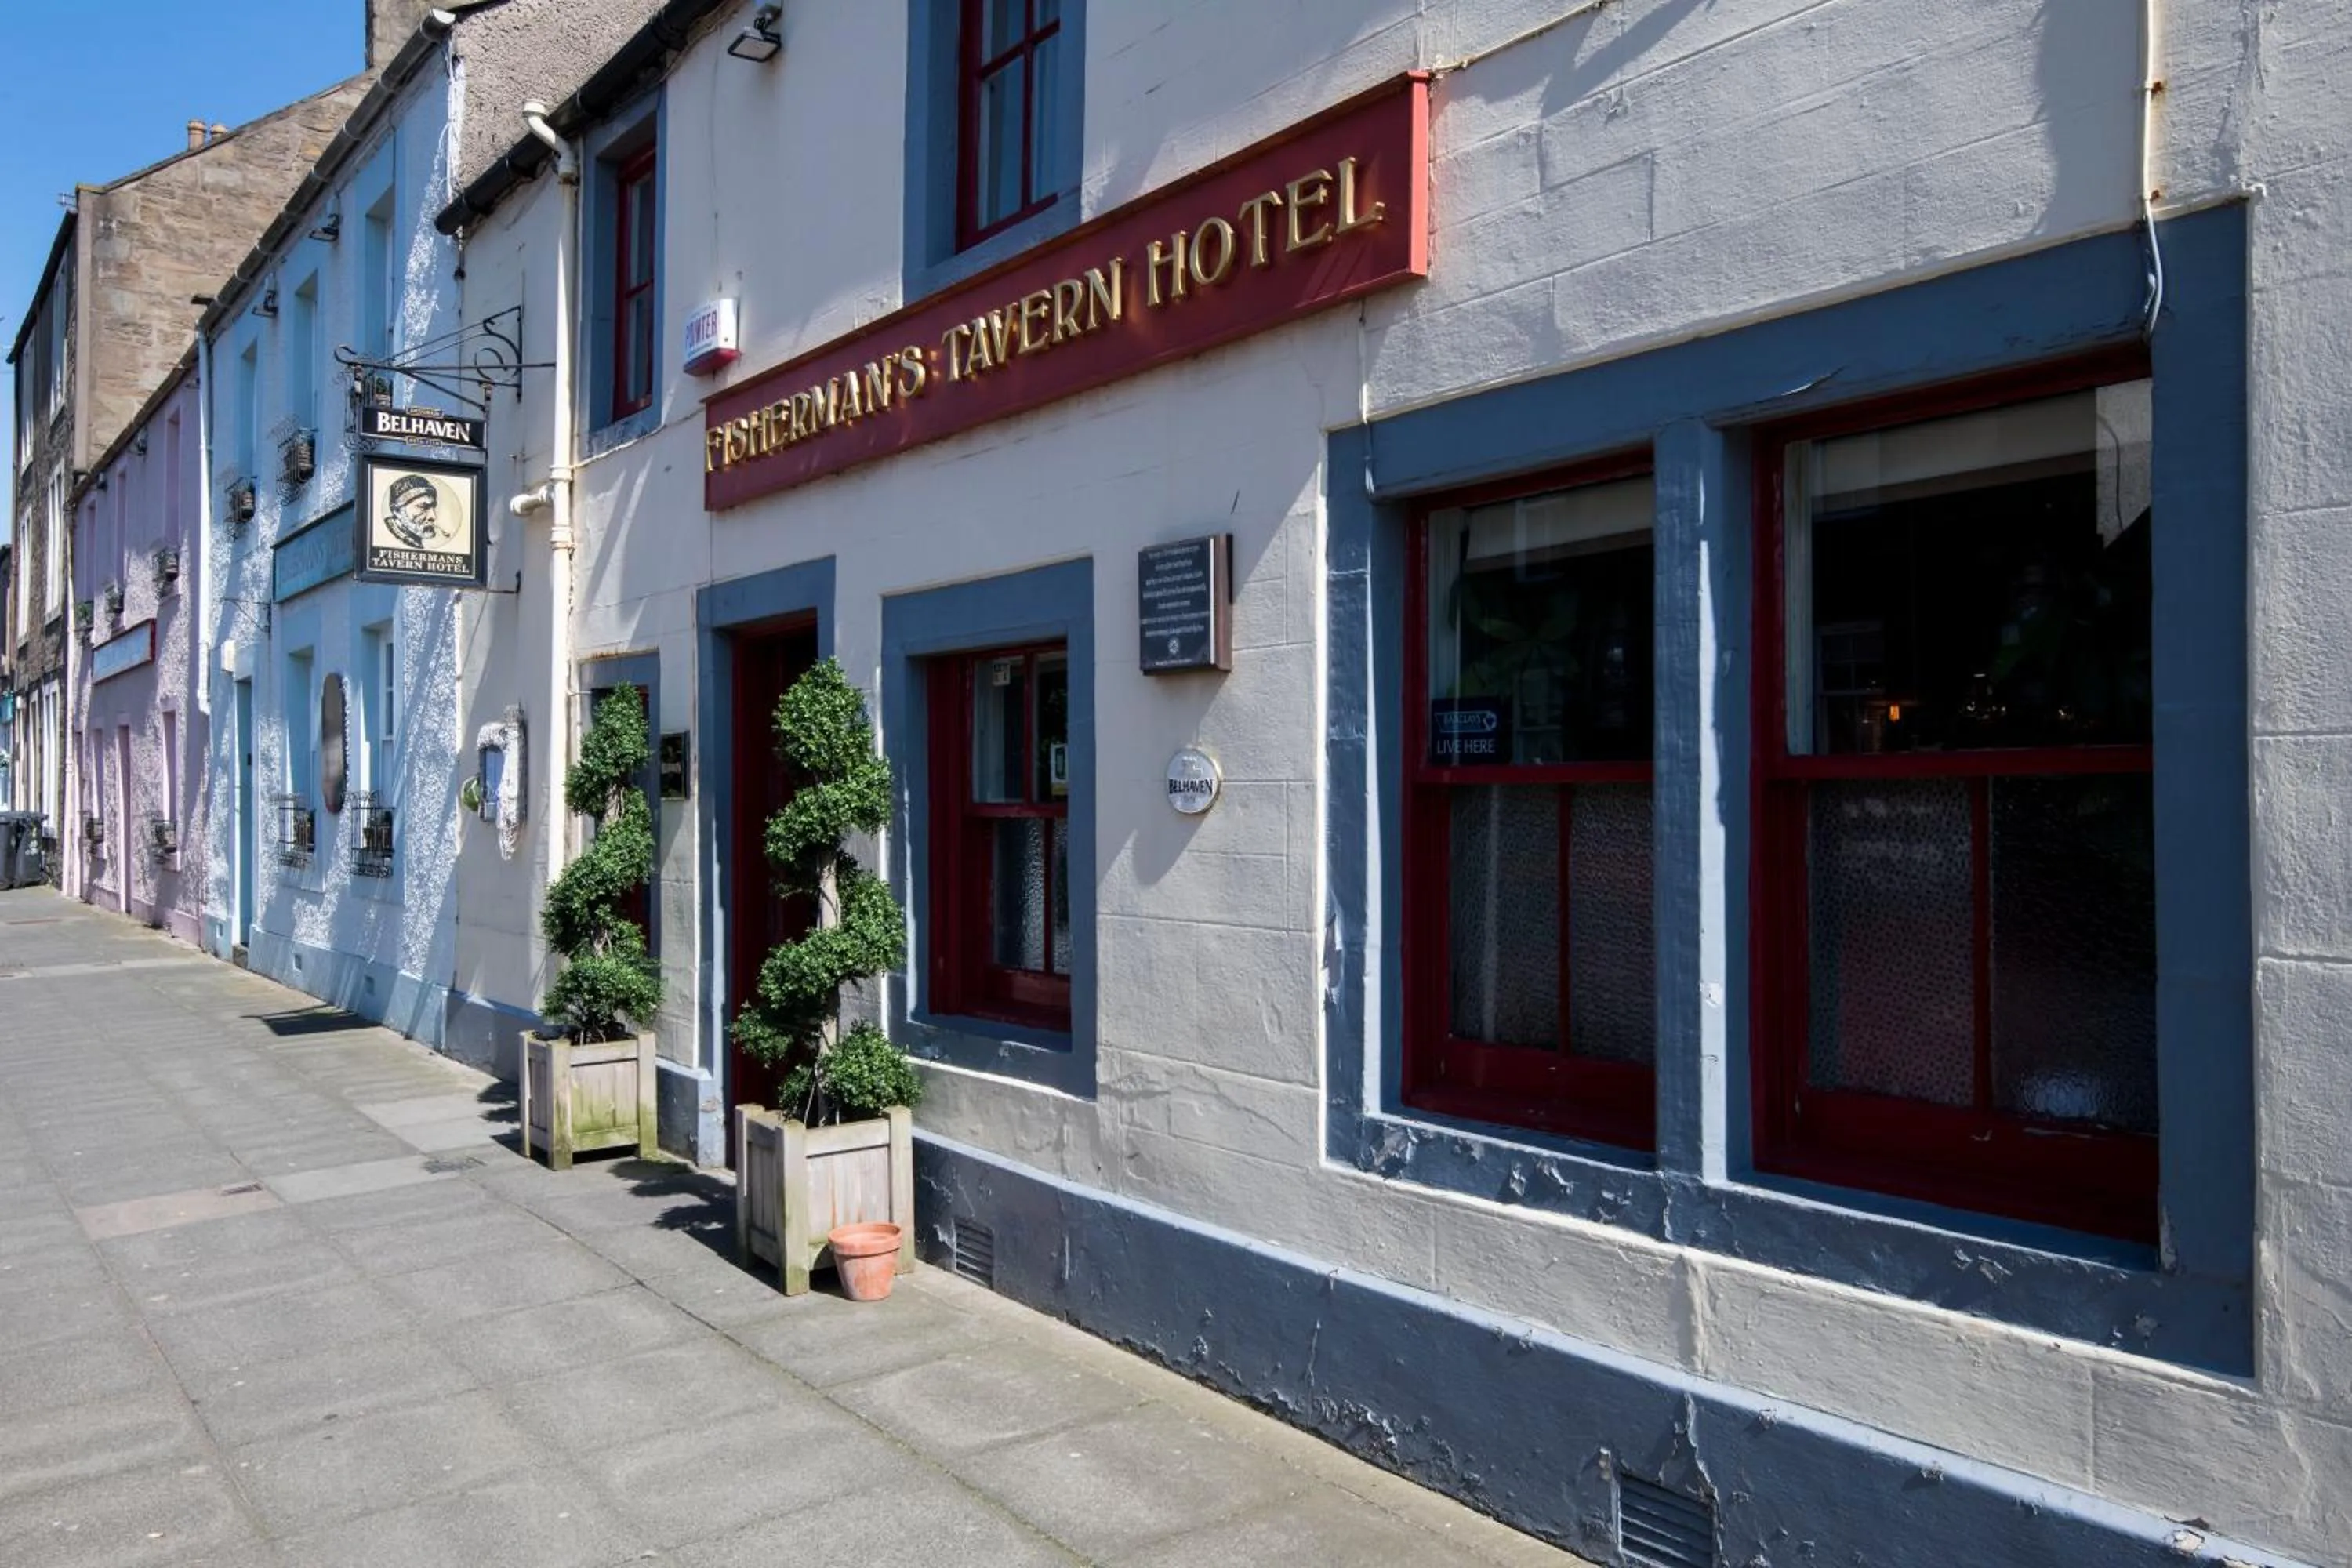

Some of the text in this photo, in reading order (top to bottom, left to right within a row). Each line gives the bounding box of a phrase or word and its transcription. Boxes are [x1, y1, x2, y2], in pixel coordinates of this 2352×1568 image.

[706, 156, 1386, 472] FISHERMAN'S TAVERN HOTEL
[377, 412, 471, 443] BELHAVEN
[379, 549, 463, 564] FISHERMANS
[372, 557, 470, 573] TAVERN HOTEL
[1437, 738, 1495, 753] LIVE HERE
[1168, 779, 1213, 795] BELHAVEN
